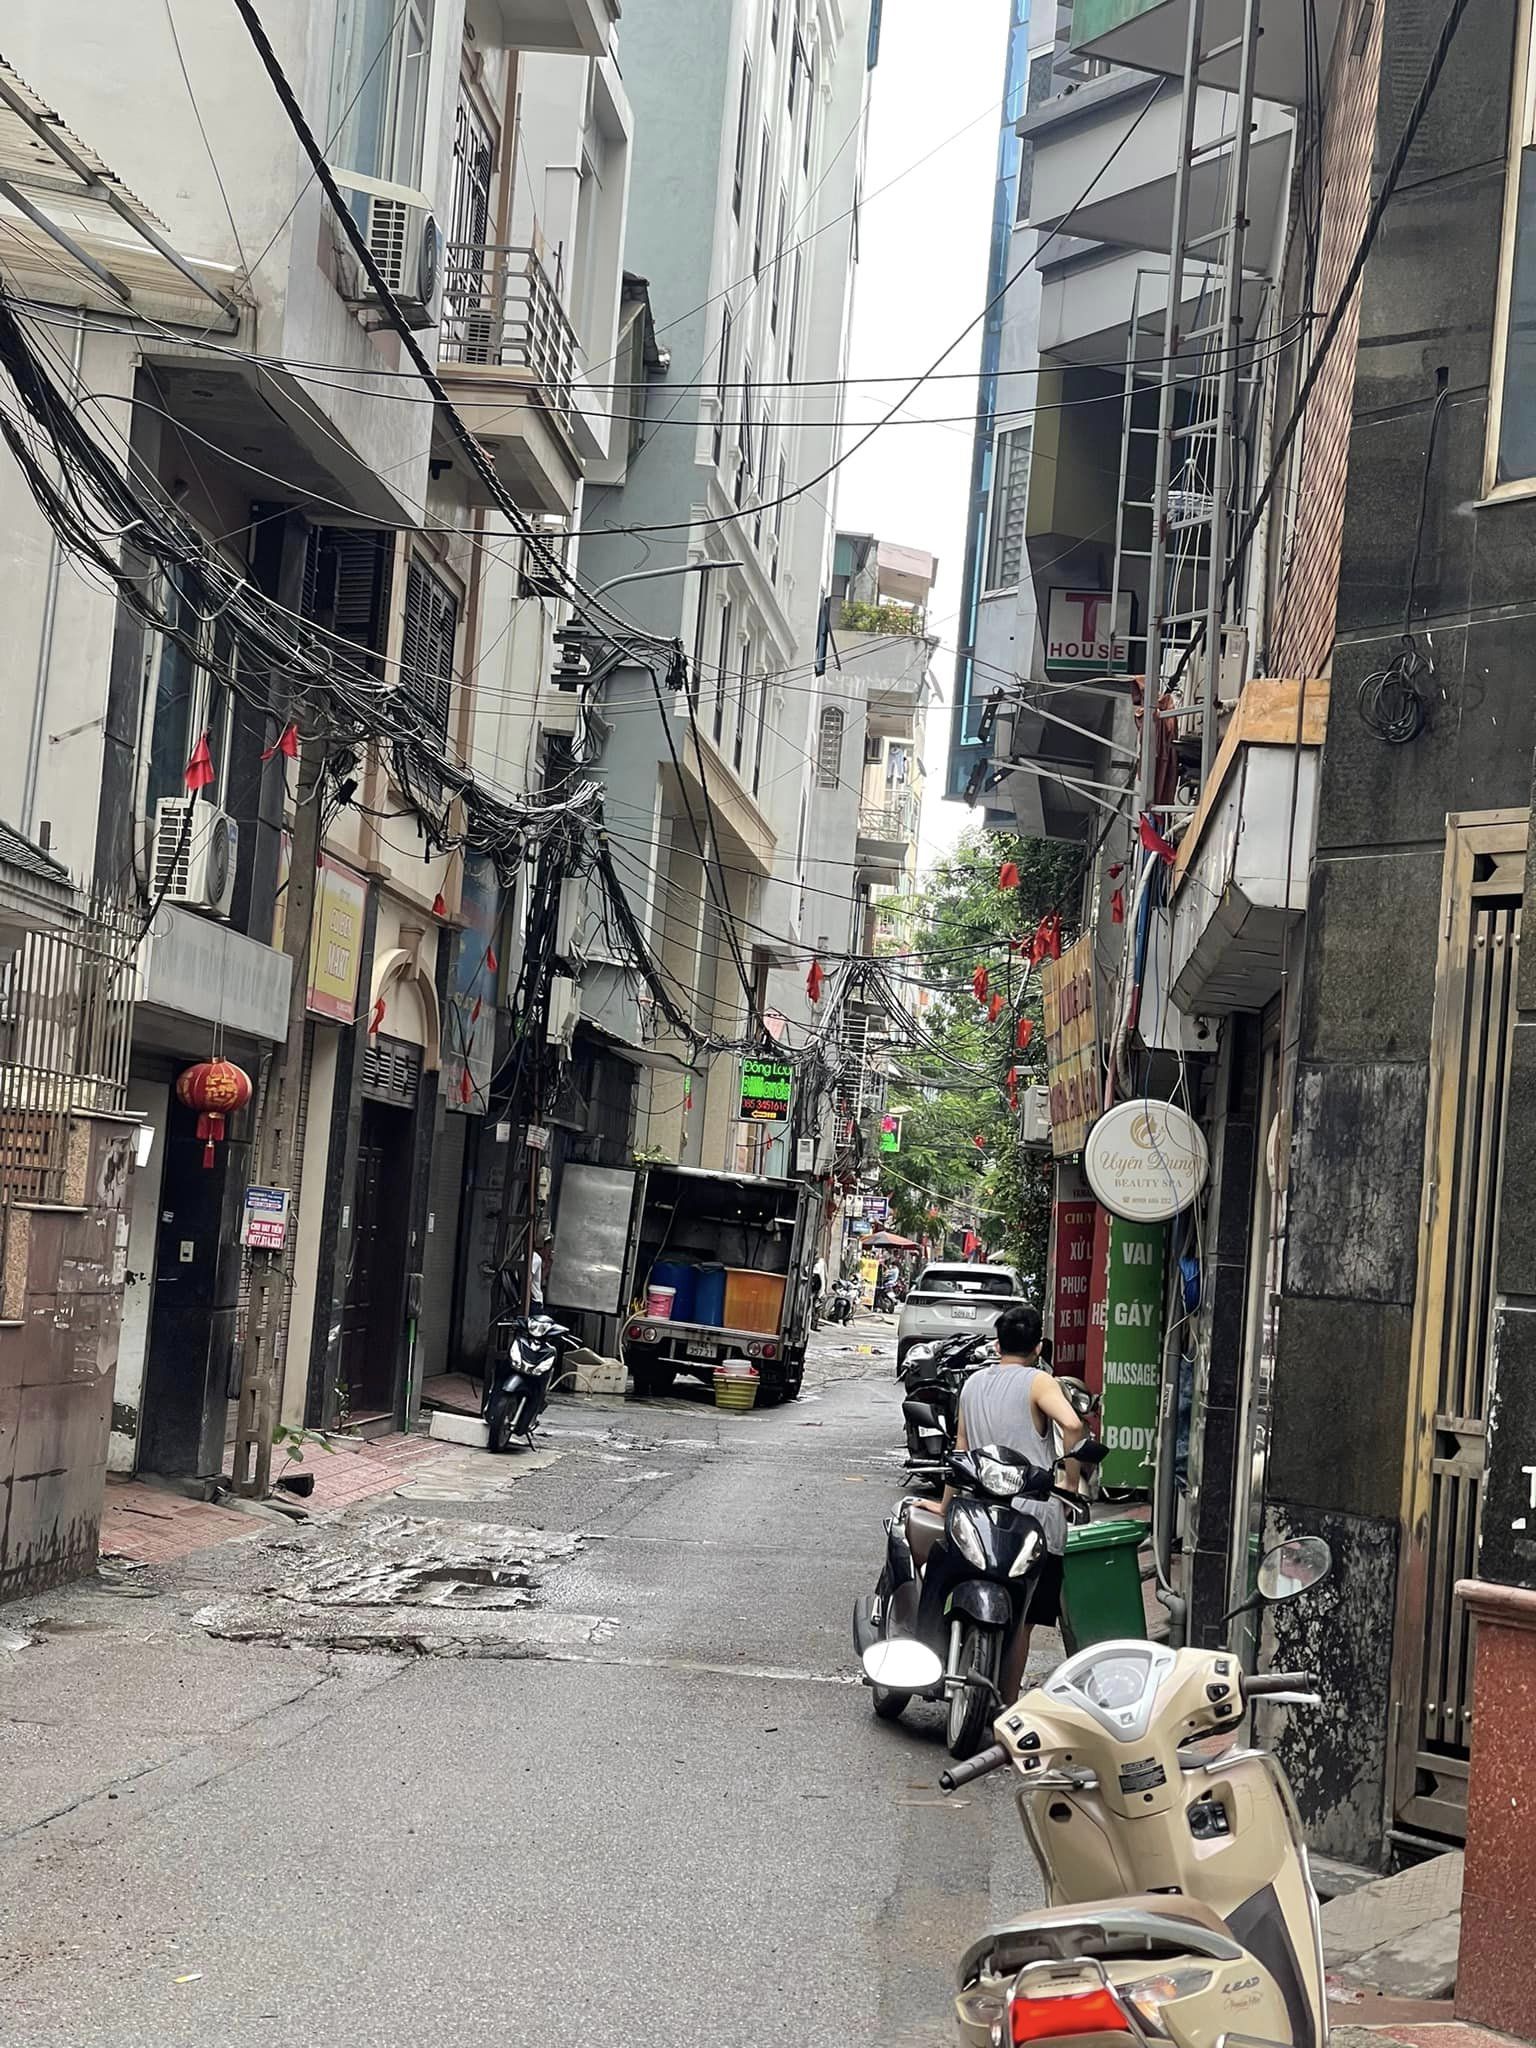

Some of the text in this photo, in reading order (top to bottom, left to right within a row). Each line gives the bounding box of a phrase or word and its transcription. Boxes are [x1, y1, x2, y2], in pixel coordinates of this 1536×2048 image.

[1050, 643, 1125, 660] HOUSE
[1114, 1179, 1159, 1188] BEAUTY
[1122, 1242, 1153, 1265] VAI
[1061, 1275, 1087, 1298] PHỤC
[1060, 1310, 1071, 1328] XE
[1114, 1299, 1154, 1327] GÁY
[1107, 1361, 1157, 1386] MASSAGE
[1106, 1426, 1155, 1450] BODY
[1221, 1975, 1260, 1994] LEAD
